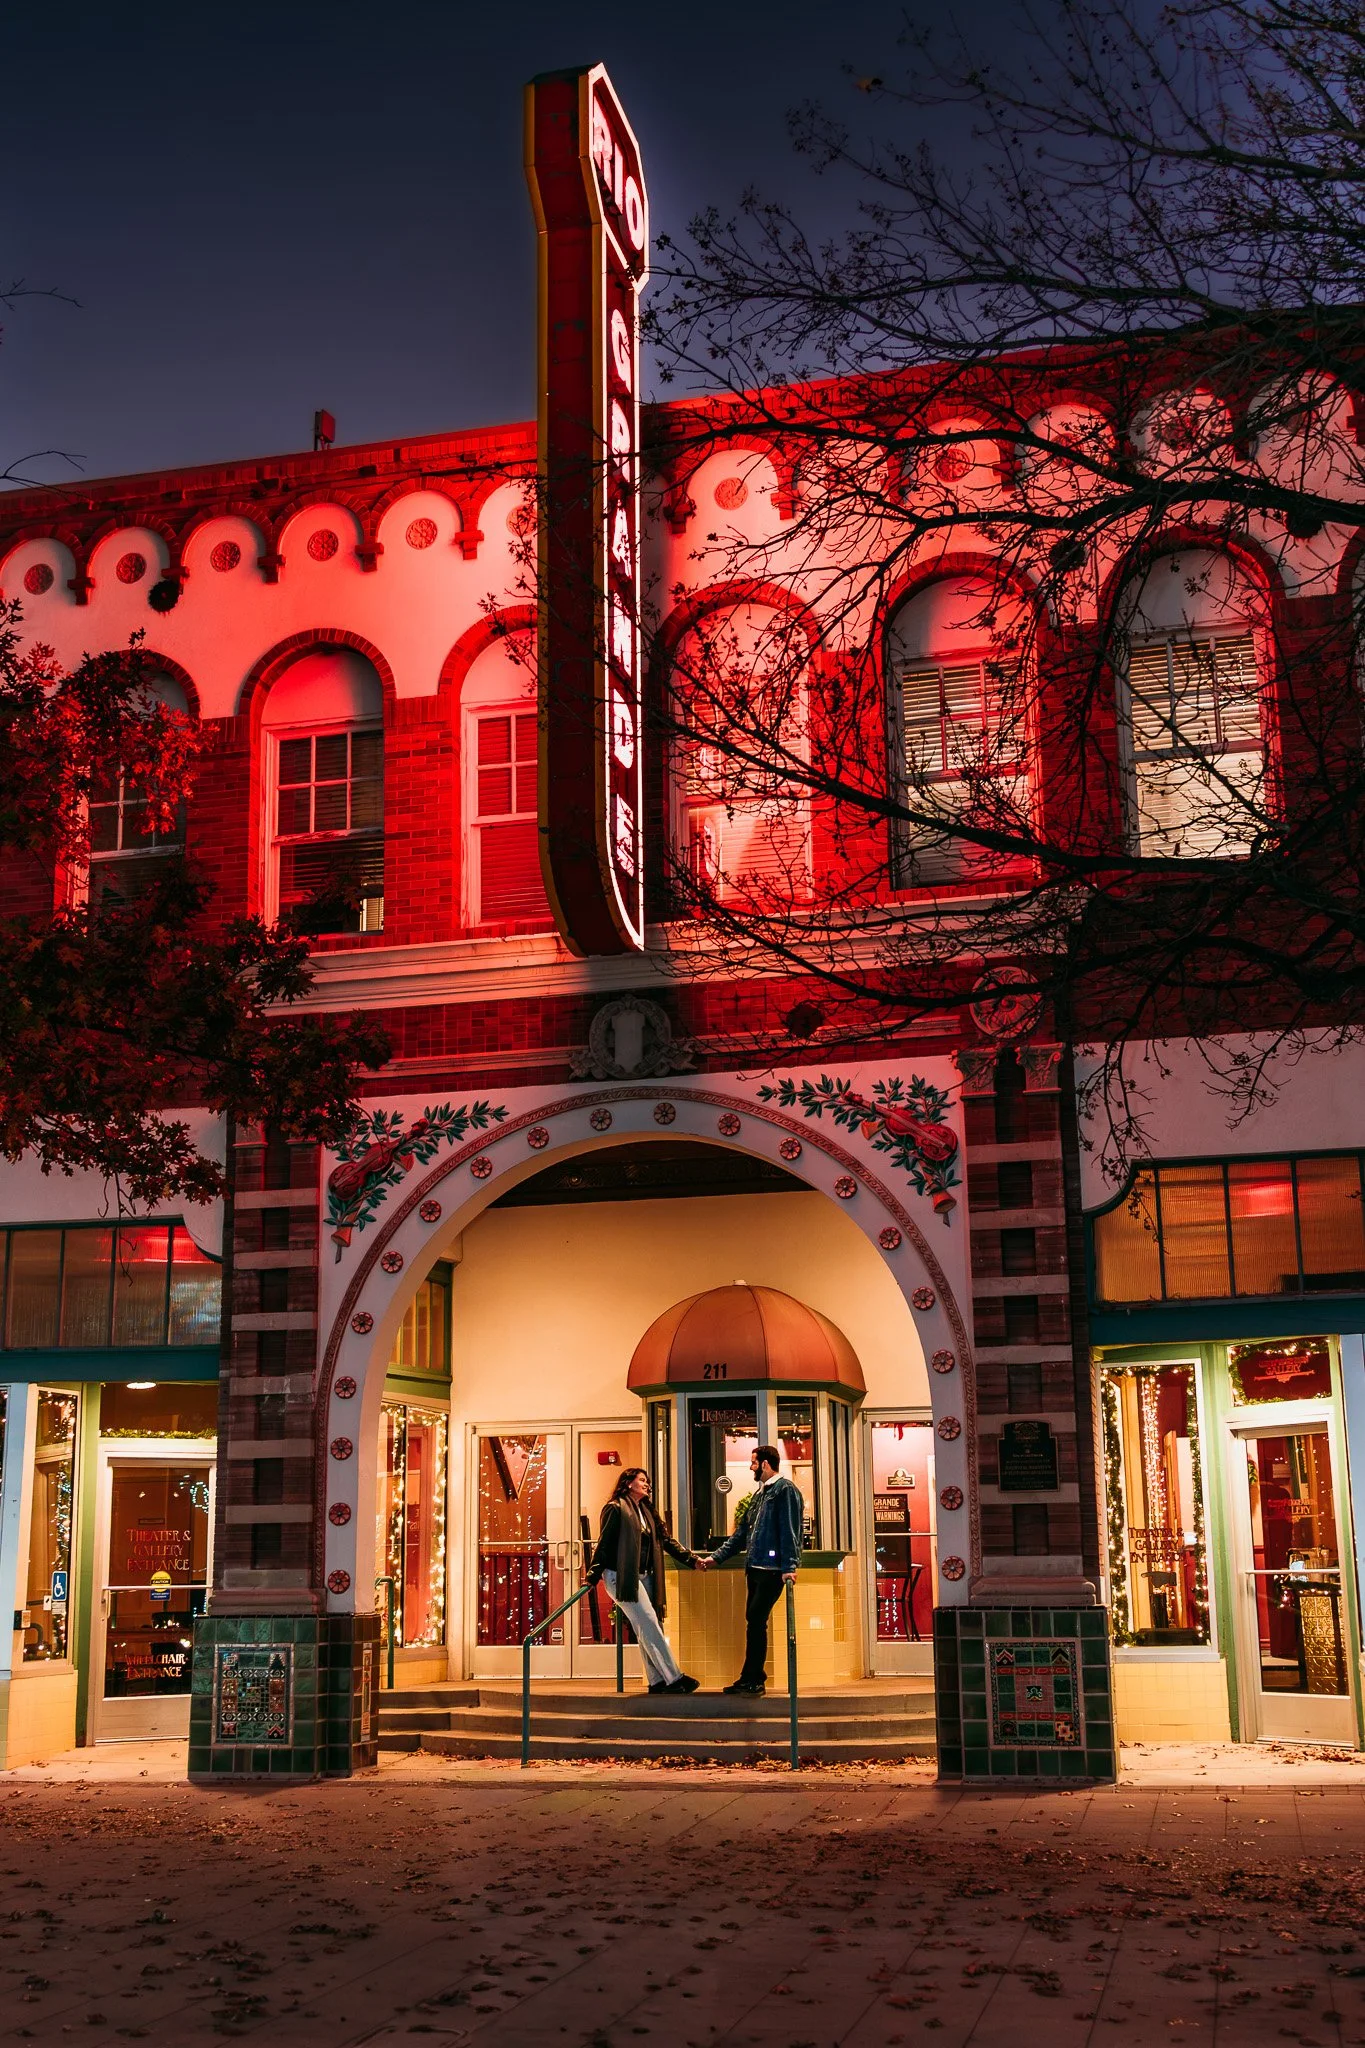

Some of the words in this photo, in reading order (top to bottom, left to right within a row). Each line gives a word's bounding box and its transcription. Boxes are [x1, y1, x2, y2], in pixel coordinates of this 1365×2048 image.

[593, 94, 645, 250] RIO
[611, 309, 635, 878] GRANDE
[703, 1363, 727, 1379] 211
[873, 1498, 900, 1507] GRANDE
[875, 1511, 905, 1521] WARNINGS
[127, 1529, 181, 1542] THEATER
[182, 1530, 191, 1541] &
[1177, 1527, 1185, 1538] &
[133, 1544, 184, 1557] GALLERY
[127, 1558, 190, 1571] ENTRANCE
[125, 1653, 186, 1665] WHEELCHAIR
[127, 1666, 182, 1679] ENTRANCE
